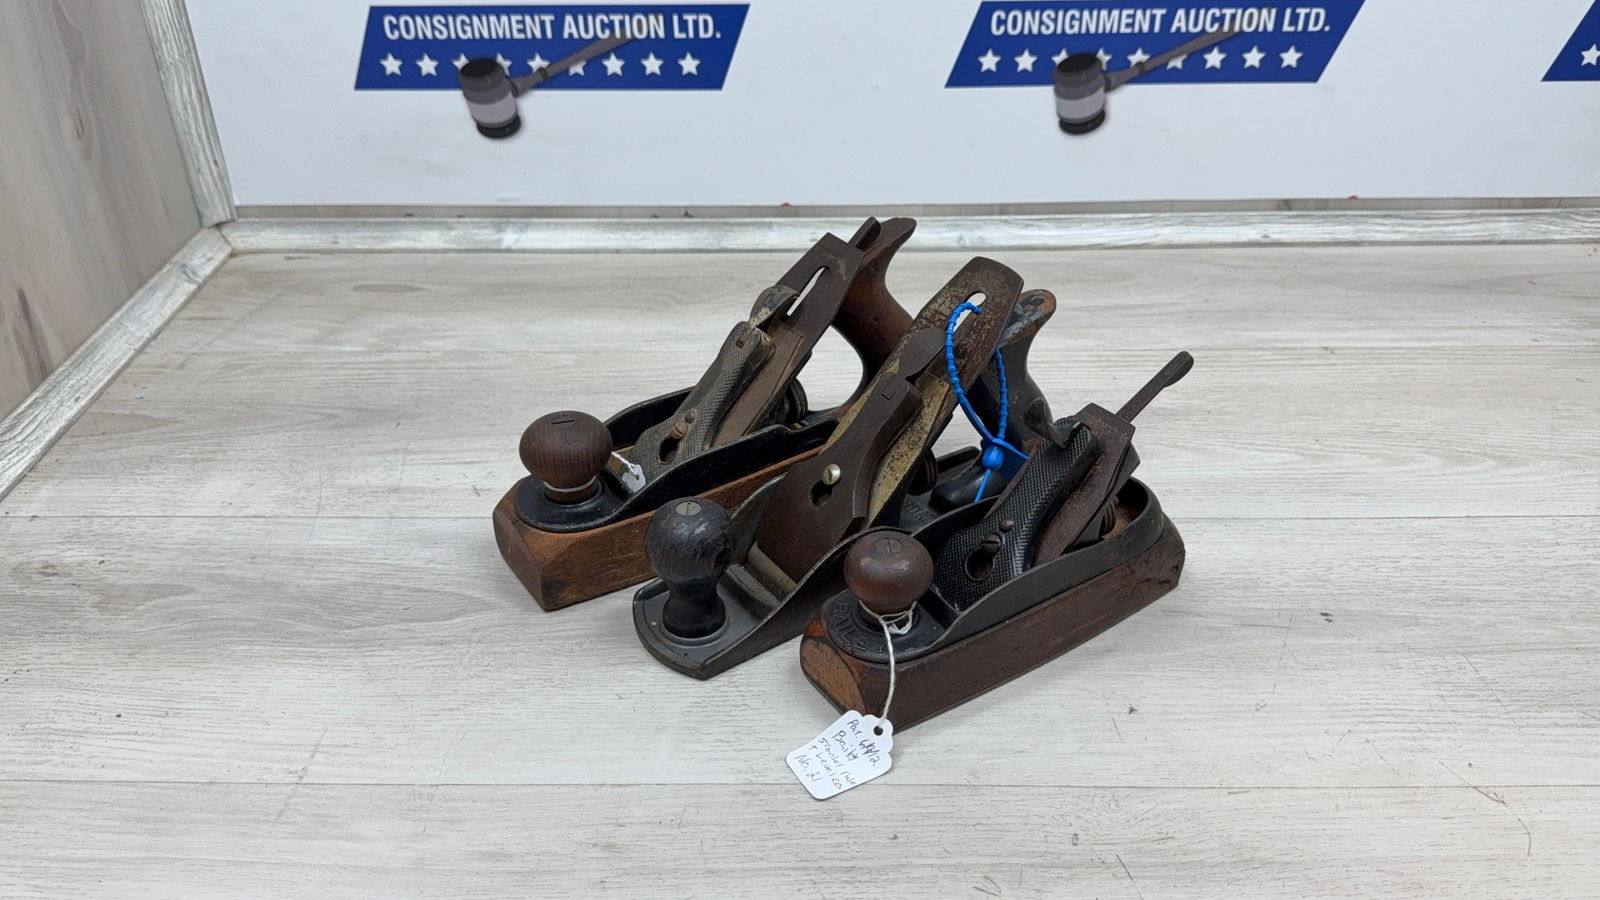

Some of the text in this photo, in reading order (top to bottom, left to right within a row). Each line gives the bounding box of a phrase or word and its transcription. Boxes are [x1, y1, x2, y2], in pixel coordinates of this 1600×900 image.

[383, 13, 721, 40] CONSIGNMENT AUCTION LTD.
[990, 7, 1331, 36] CONSIGNMENT AUCTION LTD.
[830, 600, 886, 654] BAILEY
[818, 737, 843, 767] Stanley
